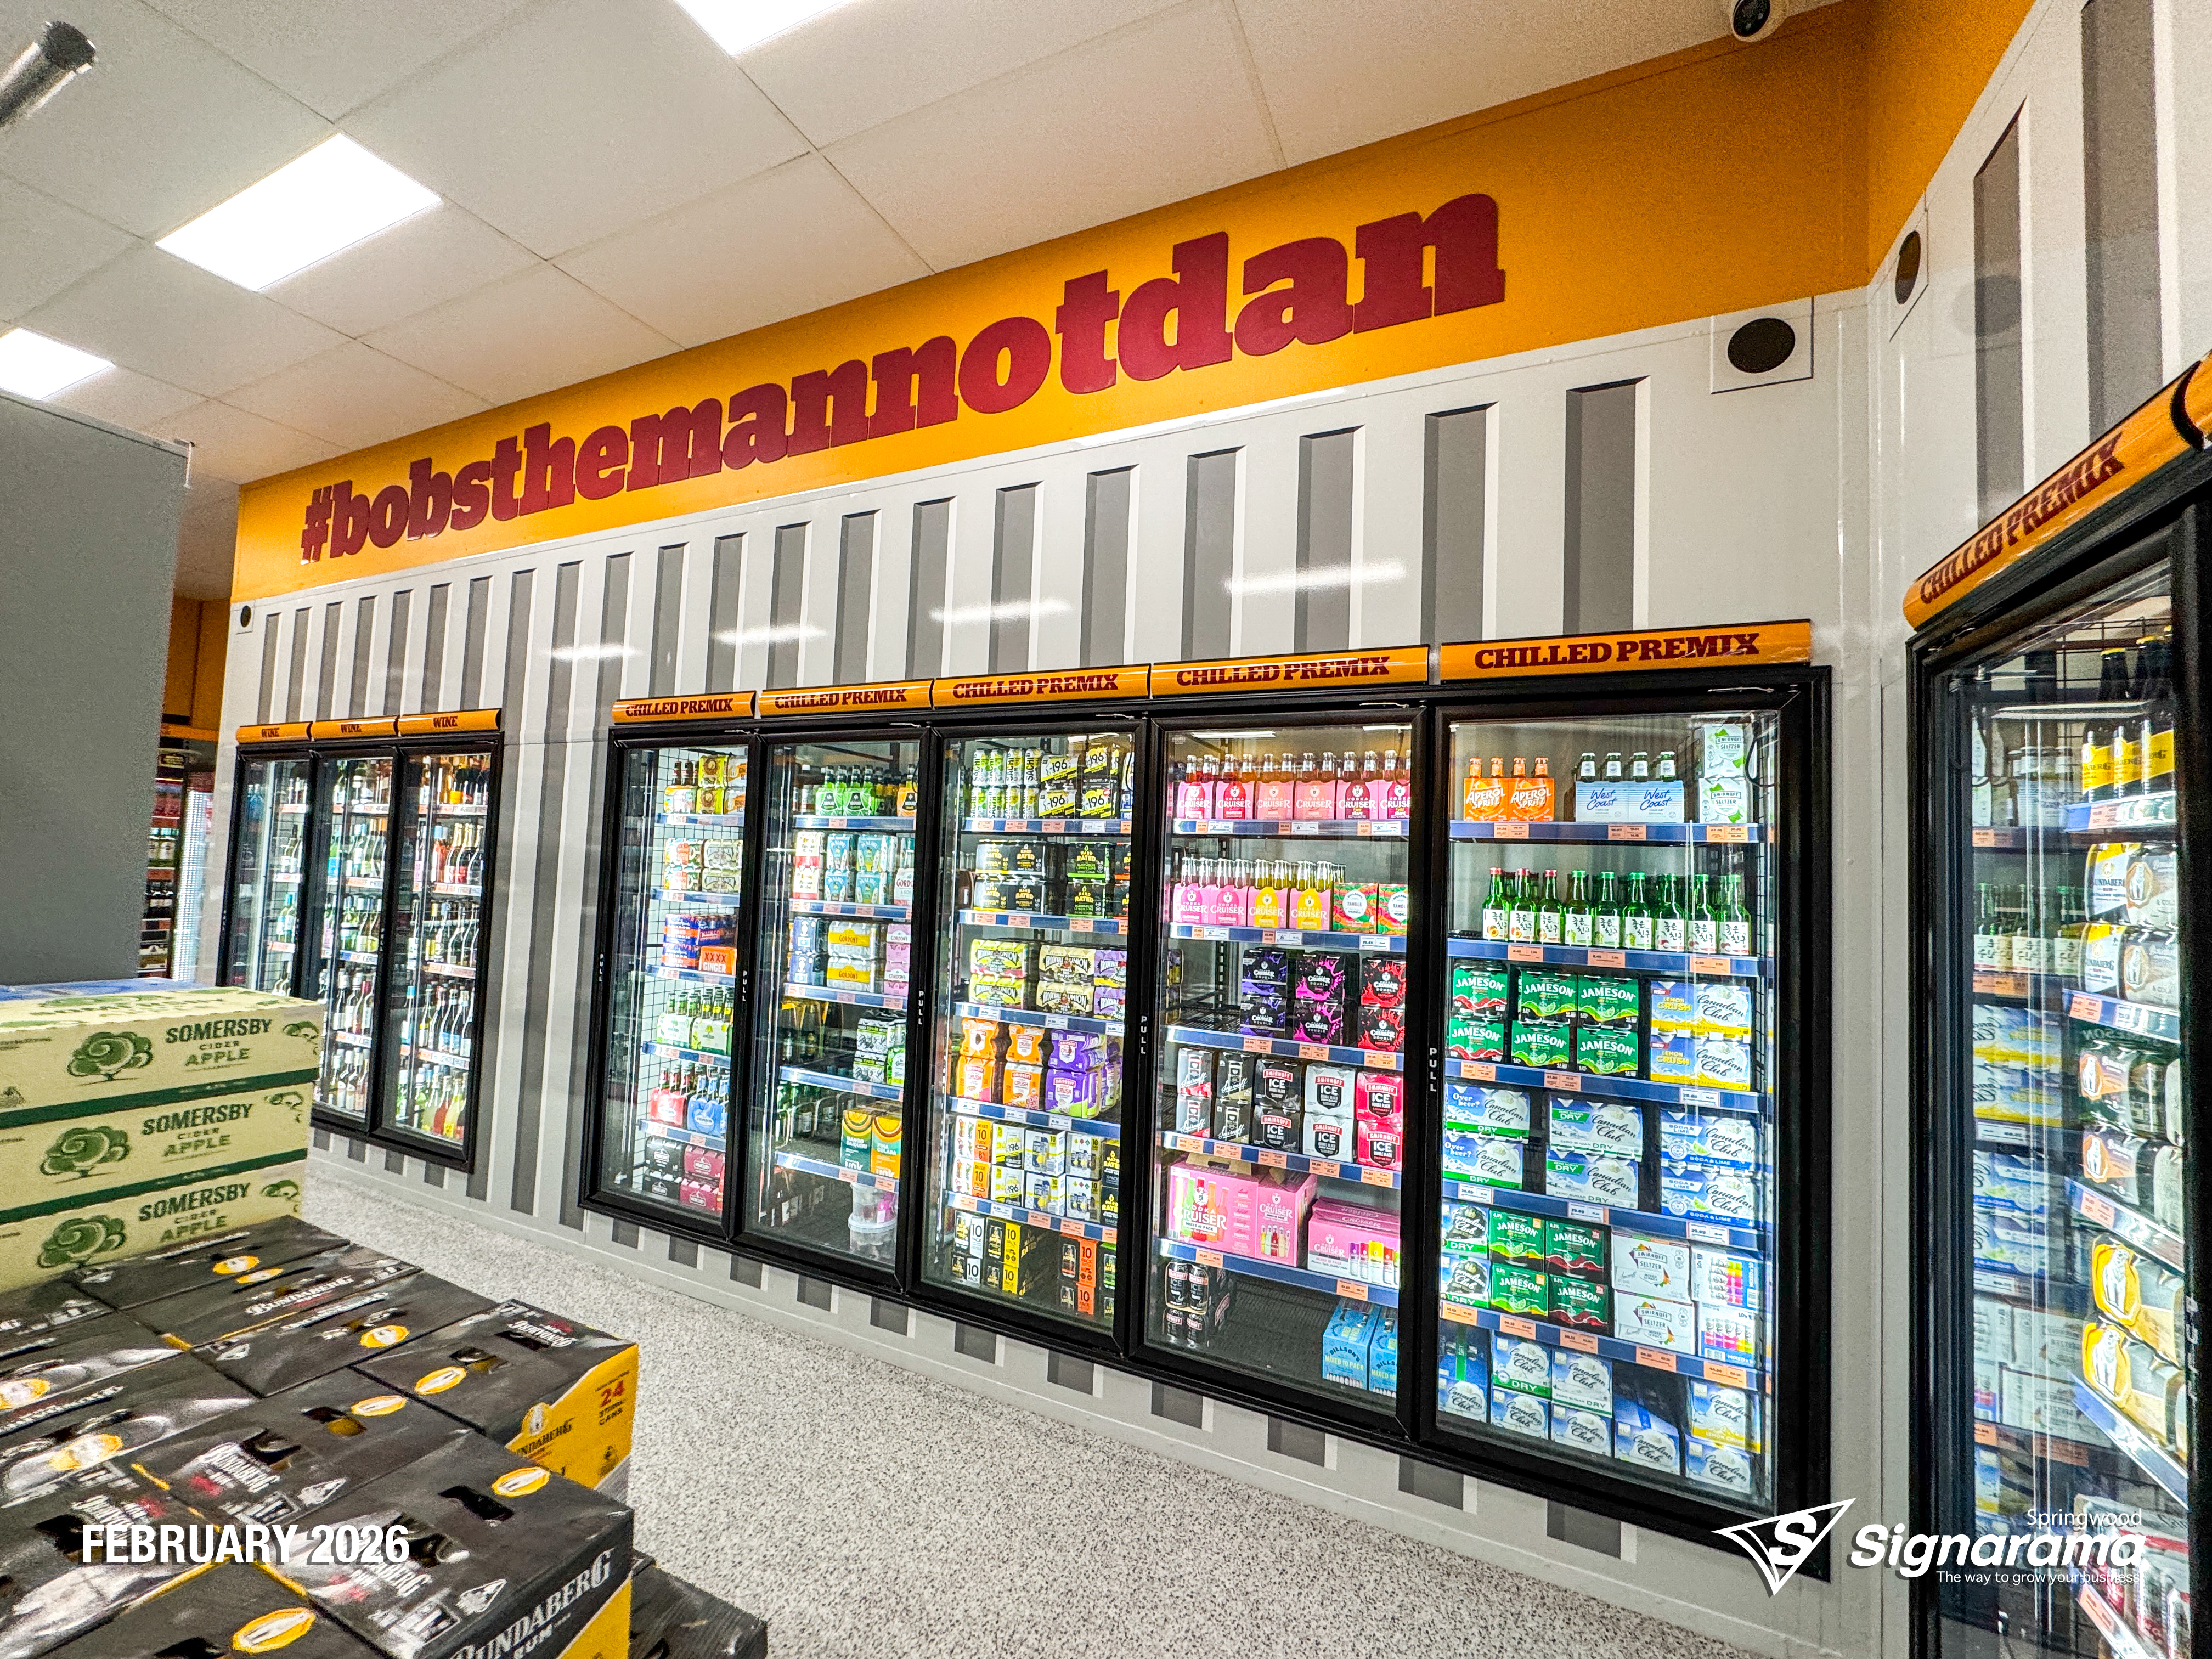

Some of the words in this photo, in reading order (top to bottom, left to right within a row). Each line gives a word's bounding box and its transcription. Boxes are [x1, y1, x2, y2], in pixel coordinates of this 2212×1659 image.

[300, 192, 1506, 565] #bobsthemannotdan
[1920, 523, 2004, 604] CHILLED
[2007, 432, 2125, 546] PREMIX
[1475, 642, 1612, 669] CHILLED
[1618, 633, 1760, 661] PREMIX
[1176, 665, 1280, 687] CHILLED
[1284, 657, 1389, 680] PREMIX
[953, 680, 1035, 698] CHILLED
[1036, 674, 1118, 695] PREMIX
[775, 693, 839, 708] CHILLED
[842, 688, 906, 704] PREMIX
[626, 702, 678, 716] CHILLED
[681, 698, 732, 713] PREMIX
[341, 723, 362, 733] WINE
[433, 716, 458, 728] WINE
[262, 727, 279, 738] WINE
[1466, 787, 1506, 804] APEROL
[1511, 787, 1550, 804] APEROL
[1592, 789, 1617, 799] West
[1645, 790, 1671, 799] West
[1217, 800, 1251, 808] CRUISER
[1257, 800, 1291, 808] CRUISER
[1296, 800, 1332, 809] CRUISER
[1338, 800, 1376, 809] CRUISER
[1472, 798, 1502, 808] SPRITZ
[1517, 798, 1546, 808] SPRITZ
[1587, 799, 1617, 810] Coast
[1640, 799, 1671, 810] Coast
[1210, 905, 1244, 915] CRUISER
[1291, 909, 1327, 919] CRUISER
[705, 952, 726, 962] XXXX
[1000, 951, 1017, 964] UNION
[703, 962, 726, 973] GINGER
[1069, 958, 1088, 972] UNION
[1456, 978, 1503, 991] JAMESON
[1524, 984, 1573, 997] JAMESON
[1581, 988, 1634, 1002] JAMESON
[1657, 1003, 1691, 1011] CRUSH
[1697, 995, 1744, 1017] Canadian
[1702, 1005, 1733, 1021] Club
[166, 1019, 272, 1044] SOMERSBY
[1452, 1028, 1499, 1042] JAMESON
[200, 1041, 239, 1051] CIDER
[1514, 1034, 1564, 1048] JAMESON
[1580, 1041, 1633, 1056] JAMESON
[185, 1049, 250, 1066] APPLE
[1656, 1056, 1690, 1065] CRUSH
[1696, 1049, 1743, 1073] Canadian
[1429, 1048, 1437, 1092] PULL
[1701, 1059, 1727, 1076] Club
[1269, 1080, 1285, 1088] ICE
[1321, 1086, 1338, 1095] ICE
[1372, 1093, 1389, 1103] ICE
[1458, 1099, 1480, 1108] beer?
[1485, 1099, 1524, 1121] Canadian
[1488, 1109, 1514, 1125] Club
[142, 1104, 252, 1135] SOMERSBY
[1592, 1114, 1636, 1138] Canadian
[178, 1128, 219, 1140] CIDER
[978, 1130, 986, 1140] 10
[1596, 1125, 1625, 1142] Club
[1706, 1128, 1754, 1153] Canadian
[165, 1135, 230, 1156] APPLE
[1444, 1142, 1464, 1150] Over
[1450, 1148, 1471, 1157] beer?
[1711, 1139, 1742, 1158] Club
[1476, 1150, 1516, 1174] Canadian
[1480, 1160, 1506, 1177] Club
[139, 1183, 250, 1221] SOMERSBY
[1186, 1205, 1215, 1214] VODKA
[1260, 1204, 1293, 1218] CRUISER
[175, 1210, 216, 1224] CIDER
[1173, 1206, 1227, 1229] CRUISER
[160, 1216, 227, 1242] APPLE
[971, 1223, 982, 1237] 10
[1007, 1229, 1016, 1240] 10
[1497, 1222, 1536, 1237] JAMESON
[1450, 1242, 1474, 1250] DRY
[1553, 1233, 1595, 1248] JAMESON
[1081, 1246, 1092, 1259] 10
[1314, 1244, 1345, 1257] CRUISER
[1637, 1252, 1664, 1260] SMIRNOFF
[1499, 1278, 1541, 1293] JAMESON
[1558, 1288, 1600, 1303] JAMESON
[1325, 1355, 1341, 1365] MIXED
[1350, 1362, 1364, 1371] PACK
[1510, 1348, 1545, 1371] Canadian
[1514, 1358, 1533, 1373] Club
[1512, 1381, 1537, 1391] DRY
[601, 1380, 624, 1407] 24
